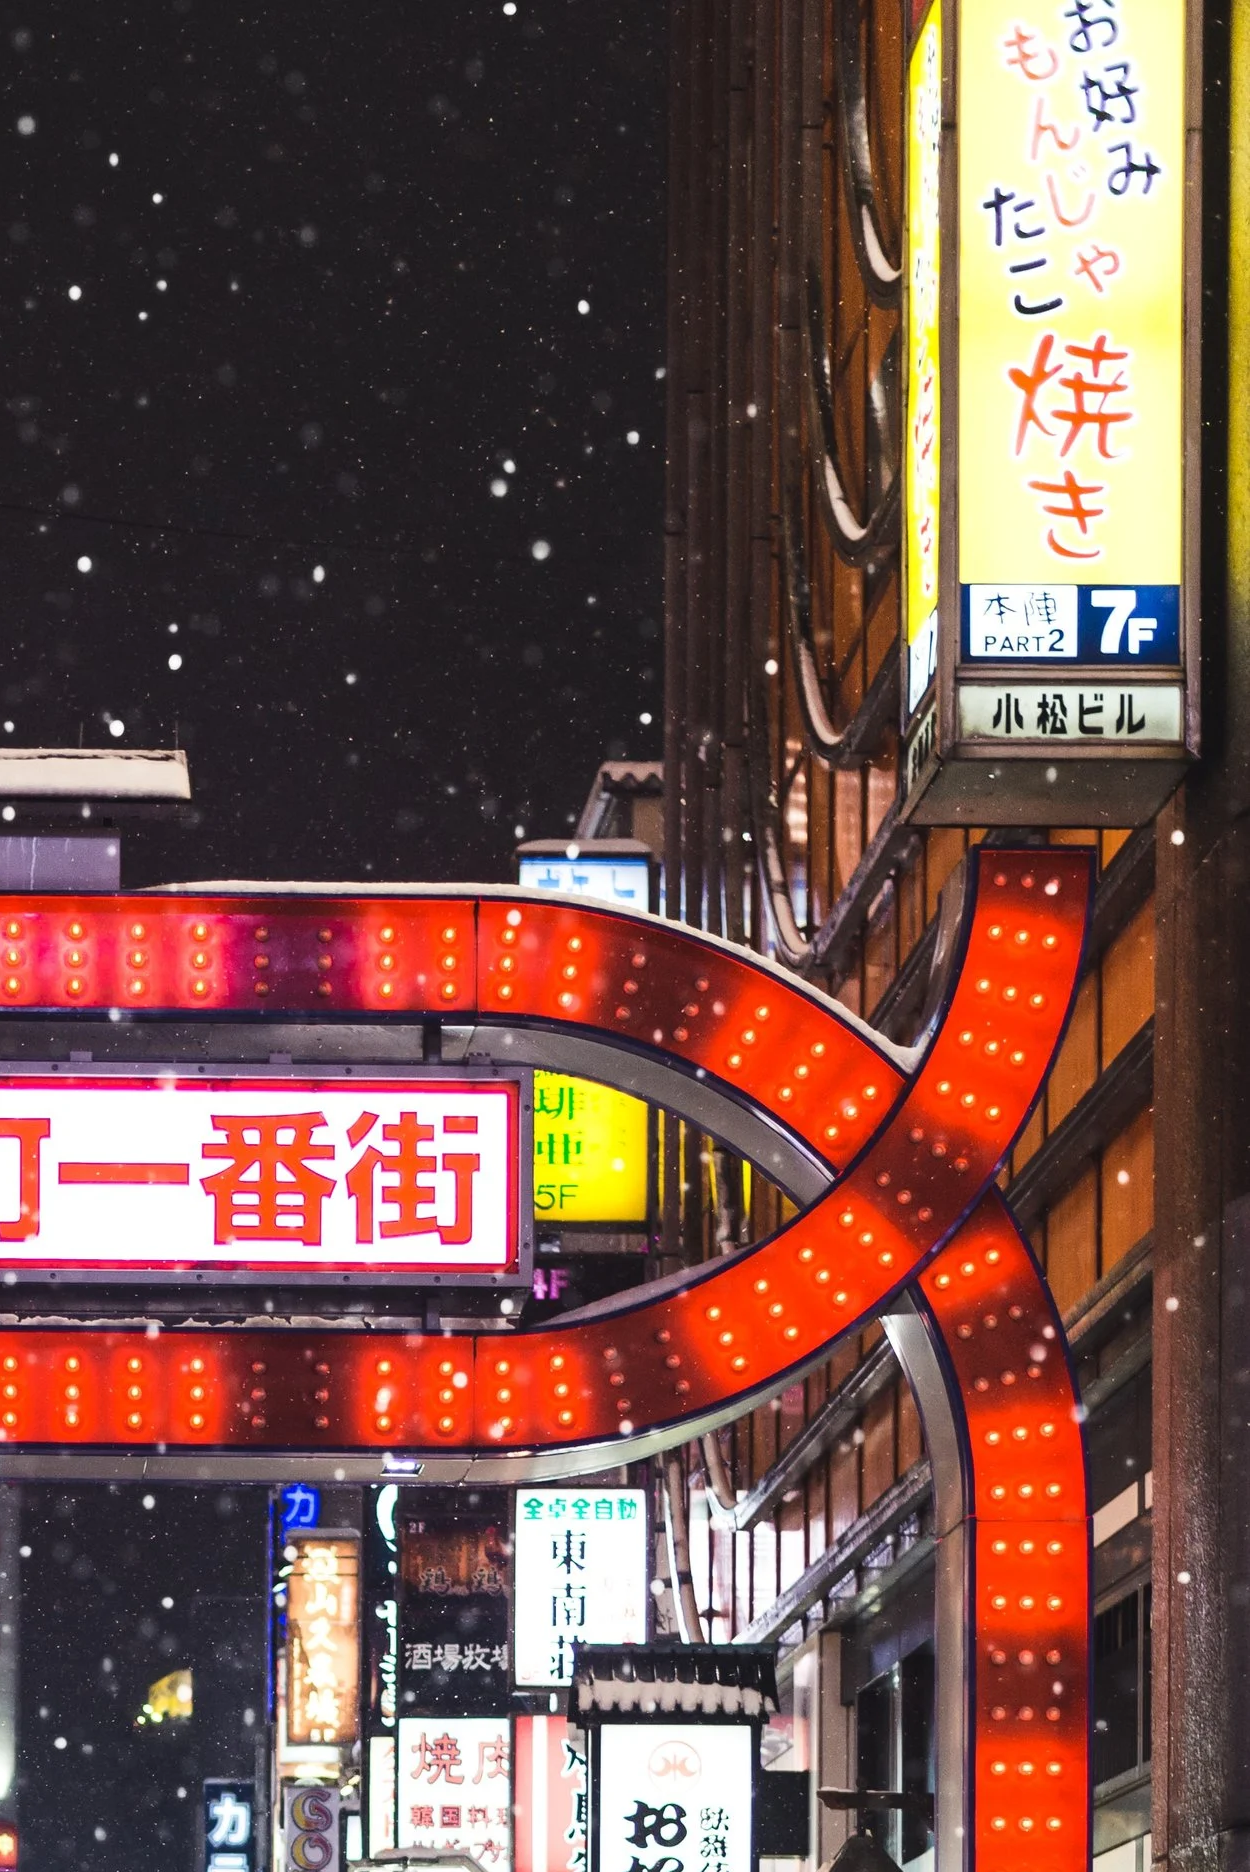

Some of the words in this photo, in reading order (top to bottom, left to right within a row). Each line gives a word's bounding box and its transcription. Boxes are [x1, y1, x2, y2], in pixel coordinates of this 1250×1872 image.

[1004, 26, 1121, 293] もんじゃ
[984, 187, 1063, 315] たこ
[1008, 334, 1134, 559] 焼き
[983, 590, 1058, 625] 本陣
[1091, 589, 1158, 655] 7F
[992, 695, 1147, 737] 小松ビル
[534, 1183, 579, 1211] 5F
[522, 1498, 638, 1520] 全卓全自動
